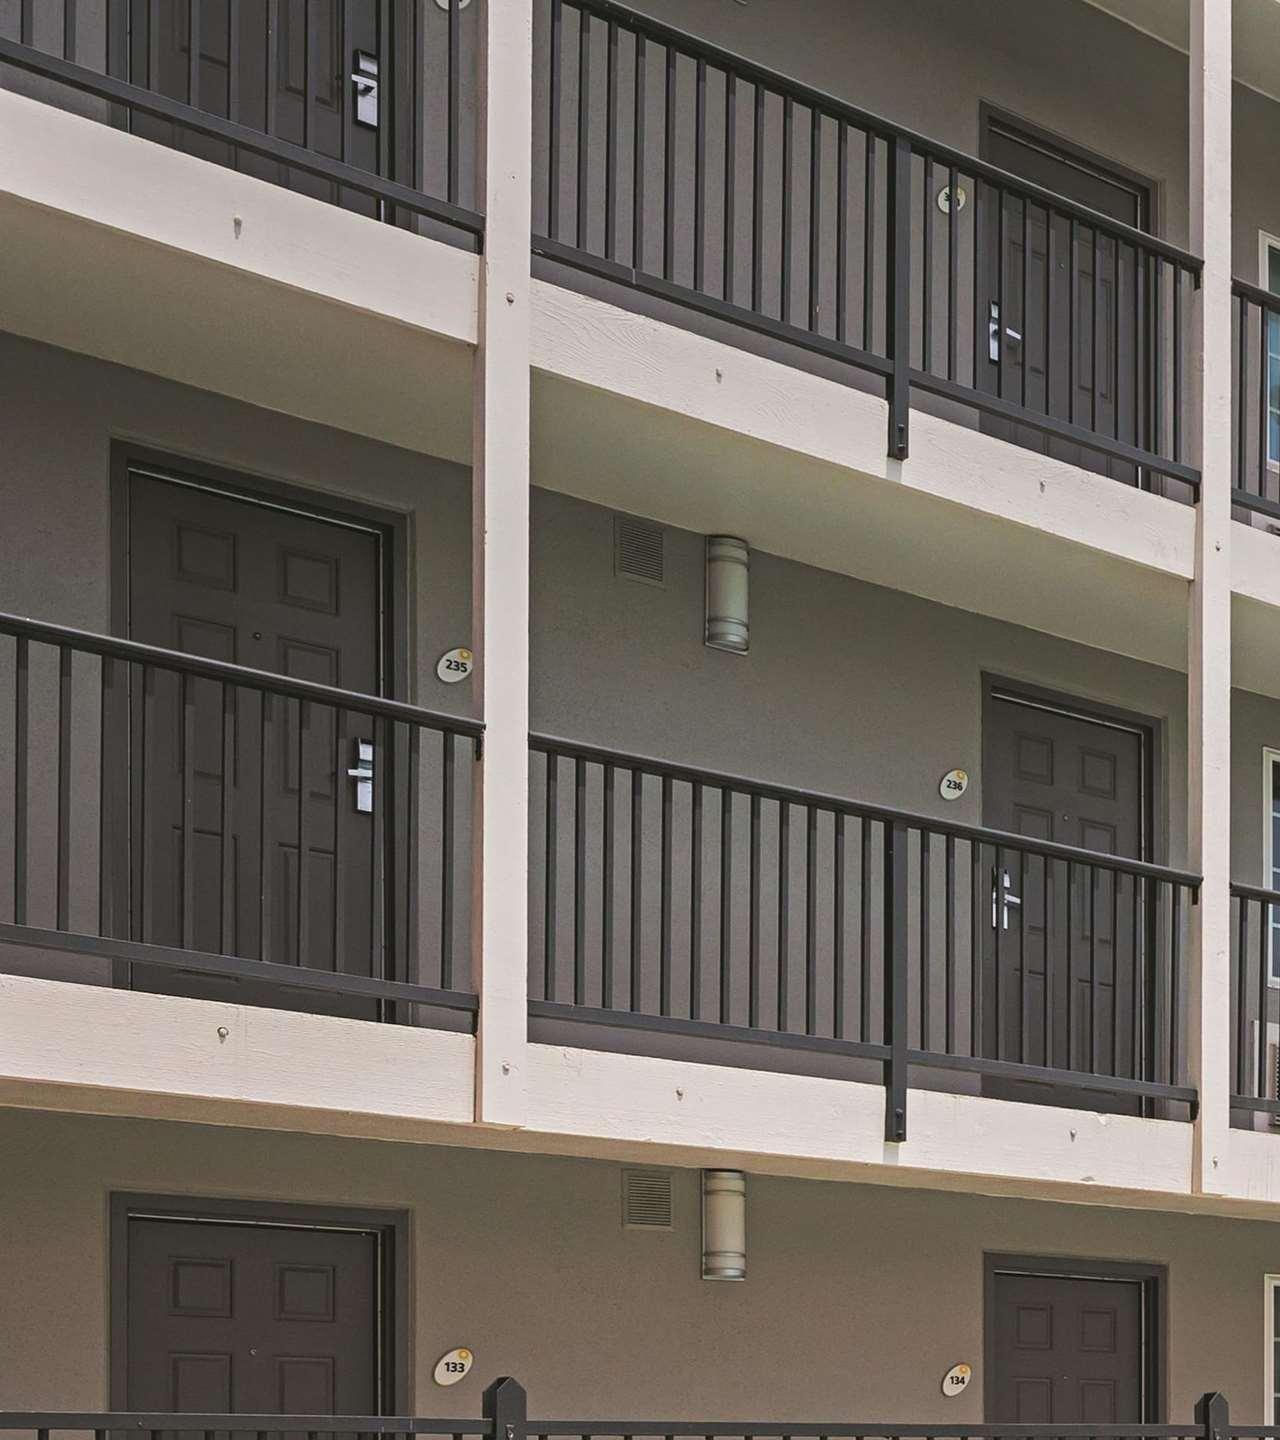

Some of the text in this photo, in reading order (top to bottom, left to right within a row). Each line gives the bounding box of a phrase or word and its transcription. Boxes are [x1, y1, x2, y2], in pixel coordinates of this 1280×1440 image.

[445, 658, 468, 673] 235
[946, 779, 963, 792] 236
[444, 1361, 465, 1373] 133
[949, 1375, 966, 1385] 134
